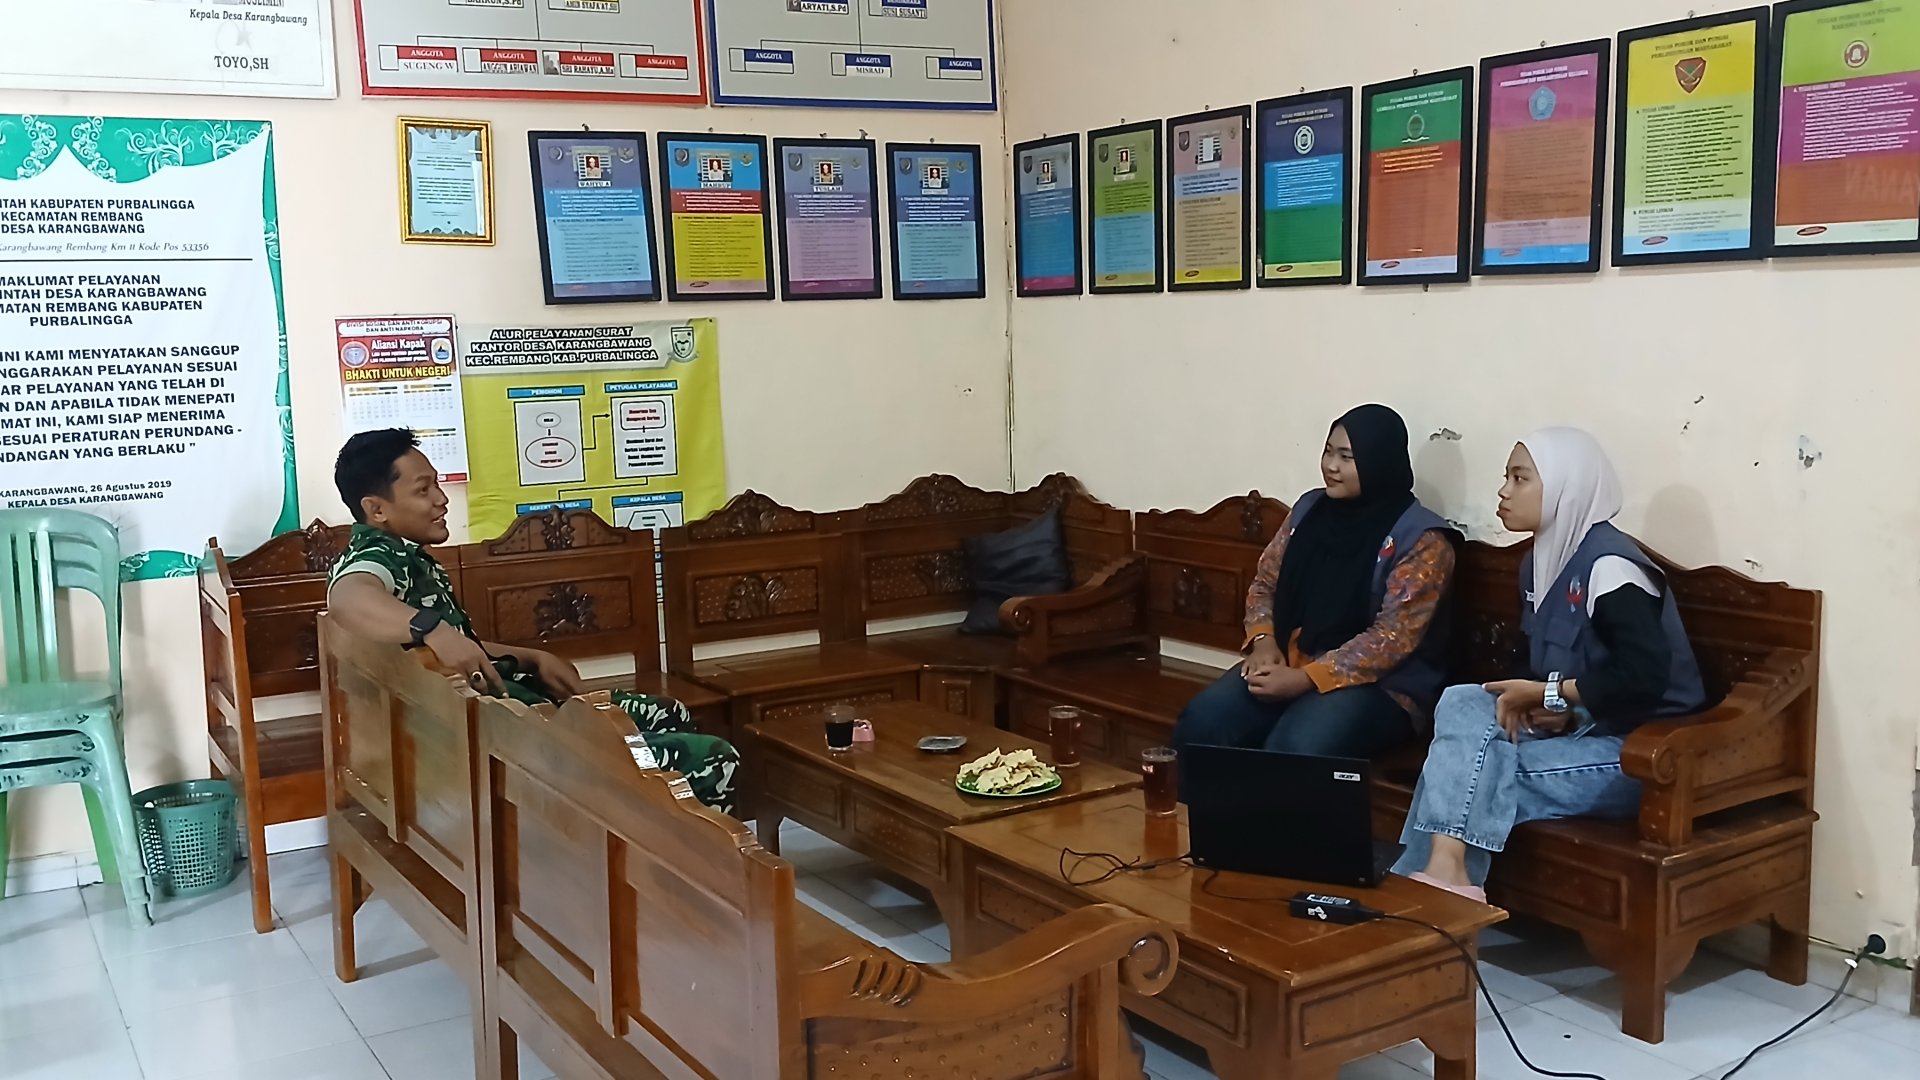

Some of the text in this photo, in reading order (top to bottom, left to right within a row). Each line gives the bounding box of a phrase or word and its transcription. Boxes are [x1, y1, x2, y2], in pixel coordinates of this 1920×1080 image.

[189, 9, 308, 26] Kepala Desa Karangbawang
[493, 52, 525, 60] ANGGOTA
[647, 58, 677, 66] ANGGOTA
[755, 52, 783, 60] ANGGOTA
[214, 55, 270, 71] TOYO,SH
[403, 62, 455, 70] SUGENG W
[30, 199, 104, 209] KABUPATEN
[107, 199, 195, 209] PURBALINGGA
[1, 212, 143, 221] KECAMATAN REMBANG
[1, 224, 145, 233] DESA KARANGBAWANG
[66, 242, 108, 253] Rembang
[111, 242, 126, 251] Km
[138, 242, 160, 251] Kode
[163, 242, 179, 251] Pos
[181, 242, 209, 252] 53356
[78, 275, 160, 285] PELAYANAN
[45, 288, 83, 299] DESA
[87, 287, 207, 298] KARANGBAWANG
[45, 301, 118, 312] REMBANG
[121, 300, 203, 311] KABUPATEN
[30, 315, 133, 327] PURBALINGGA
[490, 326, 633, 340] ALUR PELAYANAN SURAT
[371, 338, 426, 350] Aliansi Kapak
[471, 338, 651, 353] KANTOR DESA KARANGBAWANG
[25, 350, 64, 361] KAMI
[68, 347, 167, 360] MENYATAKAN
[170, 345, 240, 357] SANGGUP
[466, 350, 659, 366] KEC.REMBANG KAB.PURBALINGGA
[97, 363, 183, 376] PELAYANAN
[187, 361, 237, 373] SESUAI
[345, 365, 450, 380] BHAKTI UNTUK NEGERI
[1, 377, 225, 396] AR PELAYANAN YANG TELAH DI
[609, 381, 673, 391] PETUGAS PELAYANAN
[14, 400, 46, 412] DAN
[51, 397, 114, 411] APABILA
[118, 395, 160, 407] TIDAK
[165, 393, 235, 406] MENEPATI
[1, 409, 226, 429] MAT INI, KAMI SIAP MENERIMA
[0, 433, 47, 447] ESUAI
[51, 429, 140, 444] PERATURAN
[144, 425, 234, 439] PERUNDANG
[73, 446, 114, 459] YANG
[118, 443, 185, 457] BERLAKU
[90, 484, 103, 492] 26
[105, 481, 146, 492] Agustus
[148, 480, 172, 489] 2019
[8, 491, 164, 509] KEPALA DESA KARANGBAWANG
